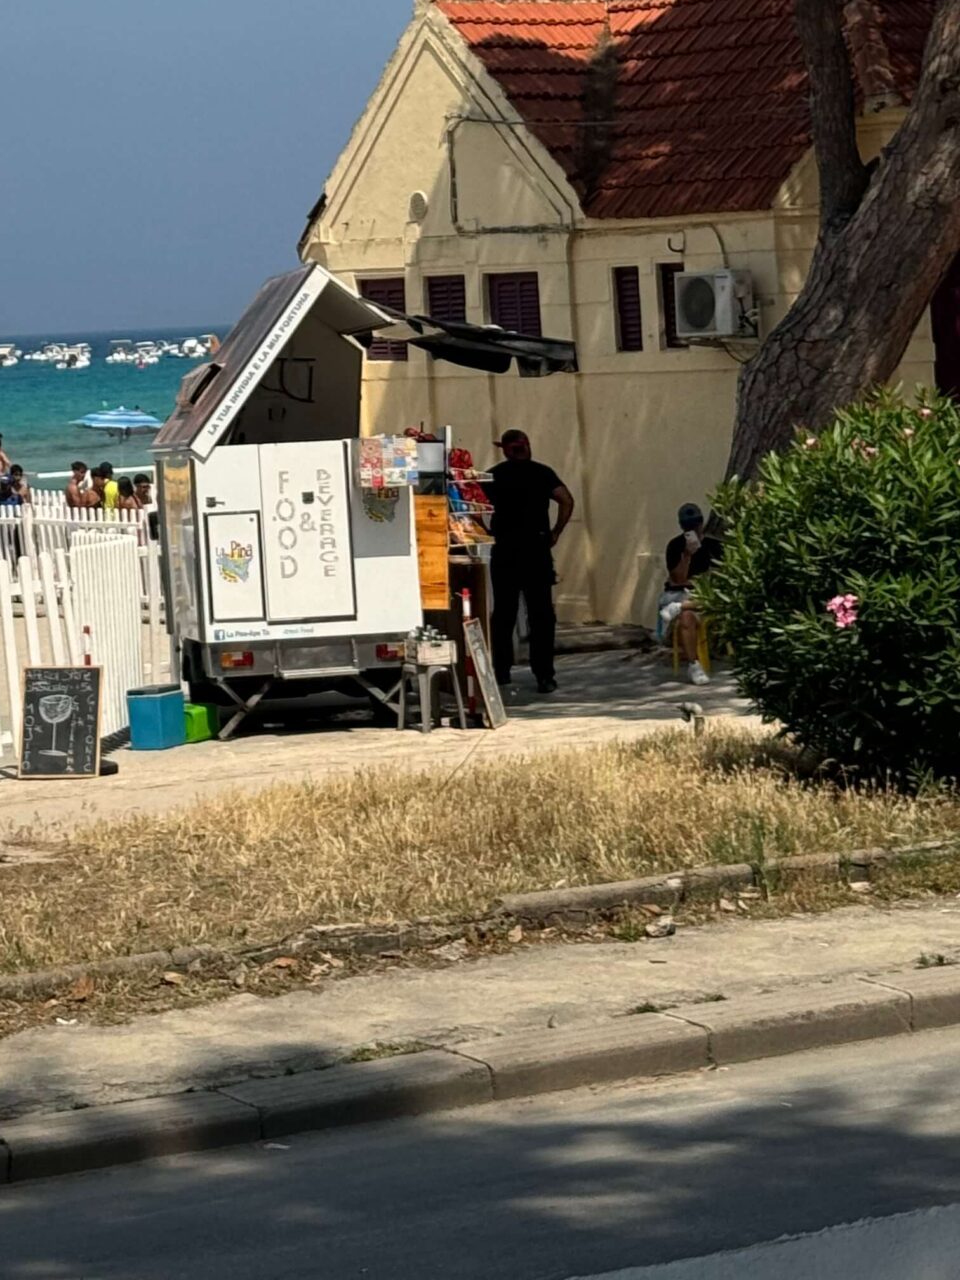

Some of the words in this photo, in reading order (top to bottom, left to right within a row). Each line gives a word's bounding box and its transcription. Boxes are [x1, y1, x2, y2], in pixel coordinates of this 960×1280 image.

[207, 423, 219, 436] LA
[217, 404, 233, 422] TUA
[230, 371, 256, 405] INVIDIA
[258, 350, 270, 362] LA
[268, 333, 282, 351] MIA
[280, 292, 310, 333] FORTUNA
[276, 471, 298, 579] FOOD
[299, 512, 317, 532] &
[316, 469, 339, 577] BEVERAGE
